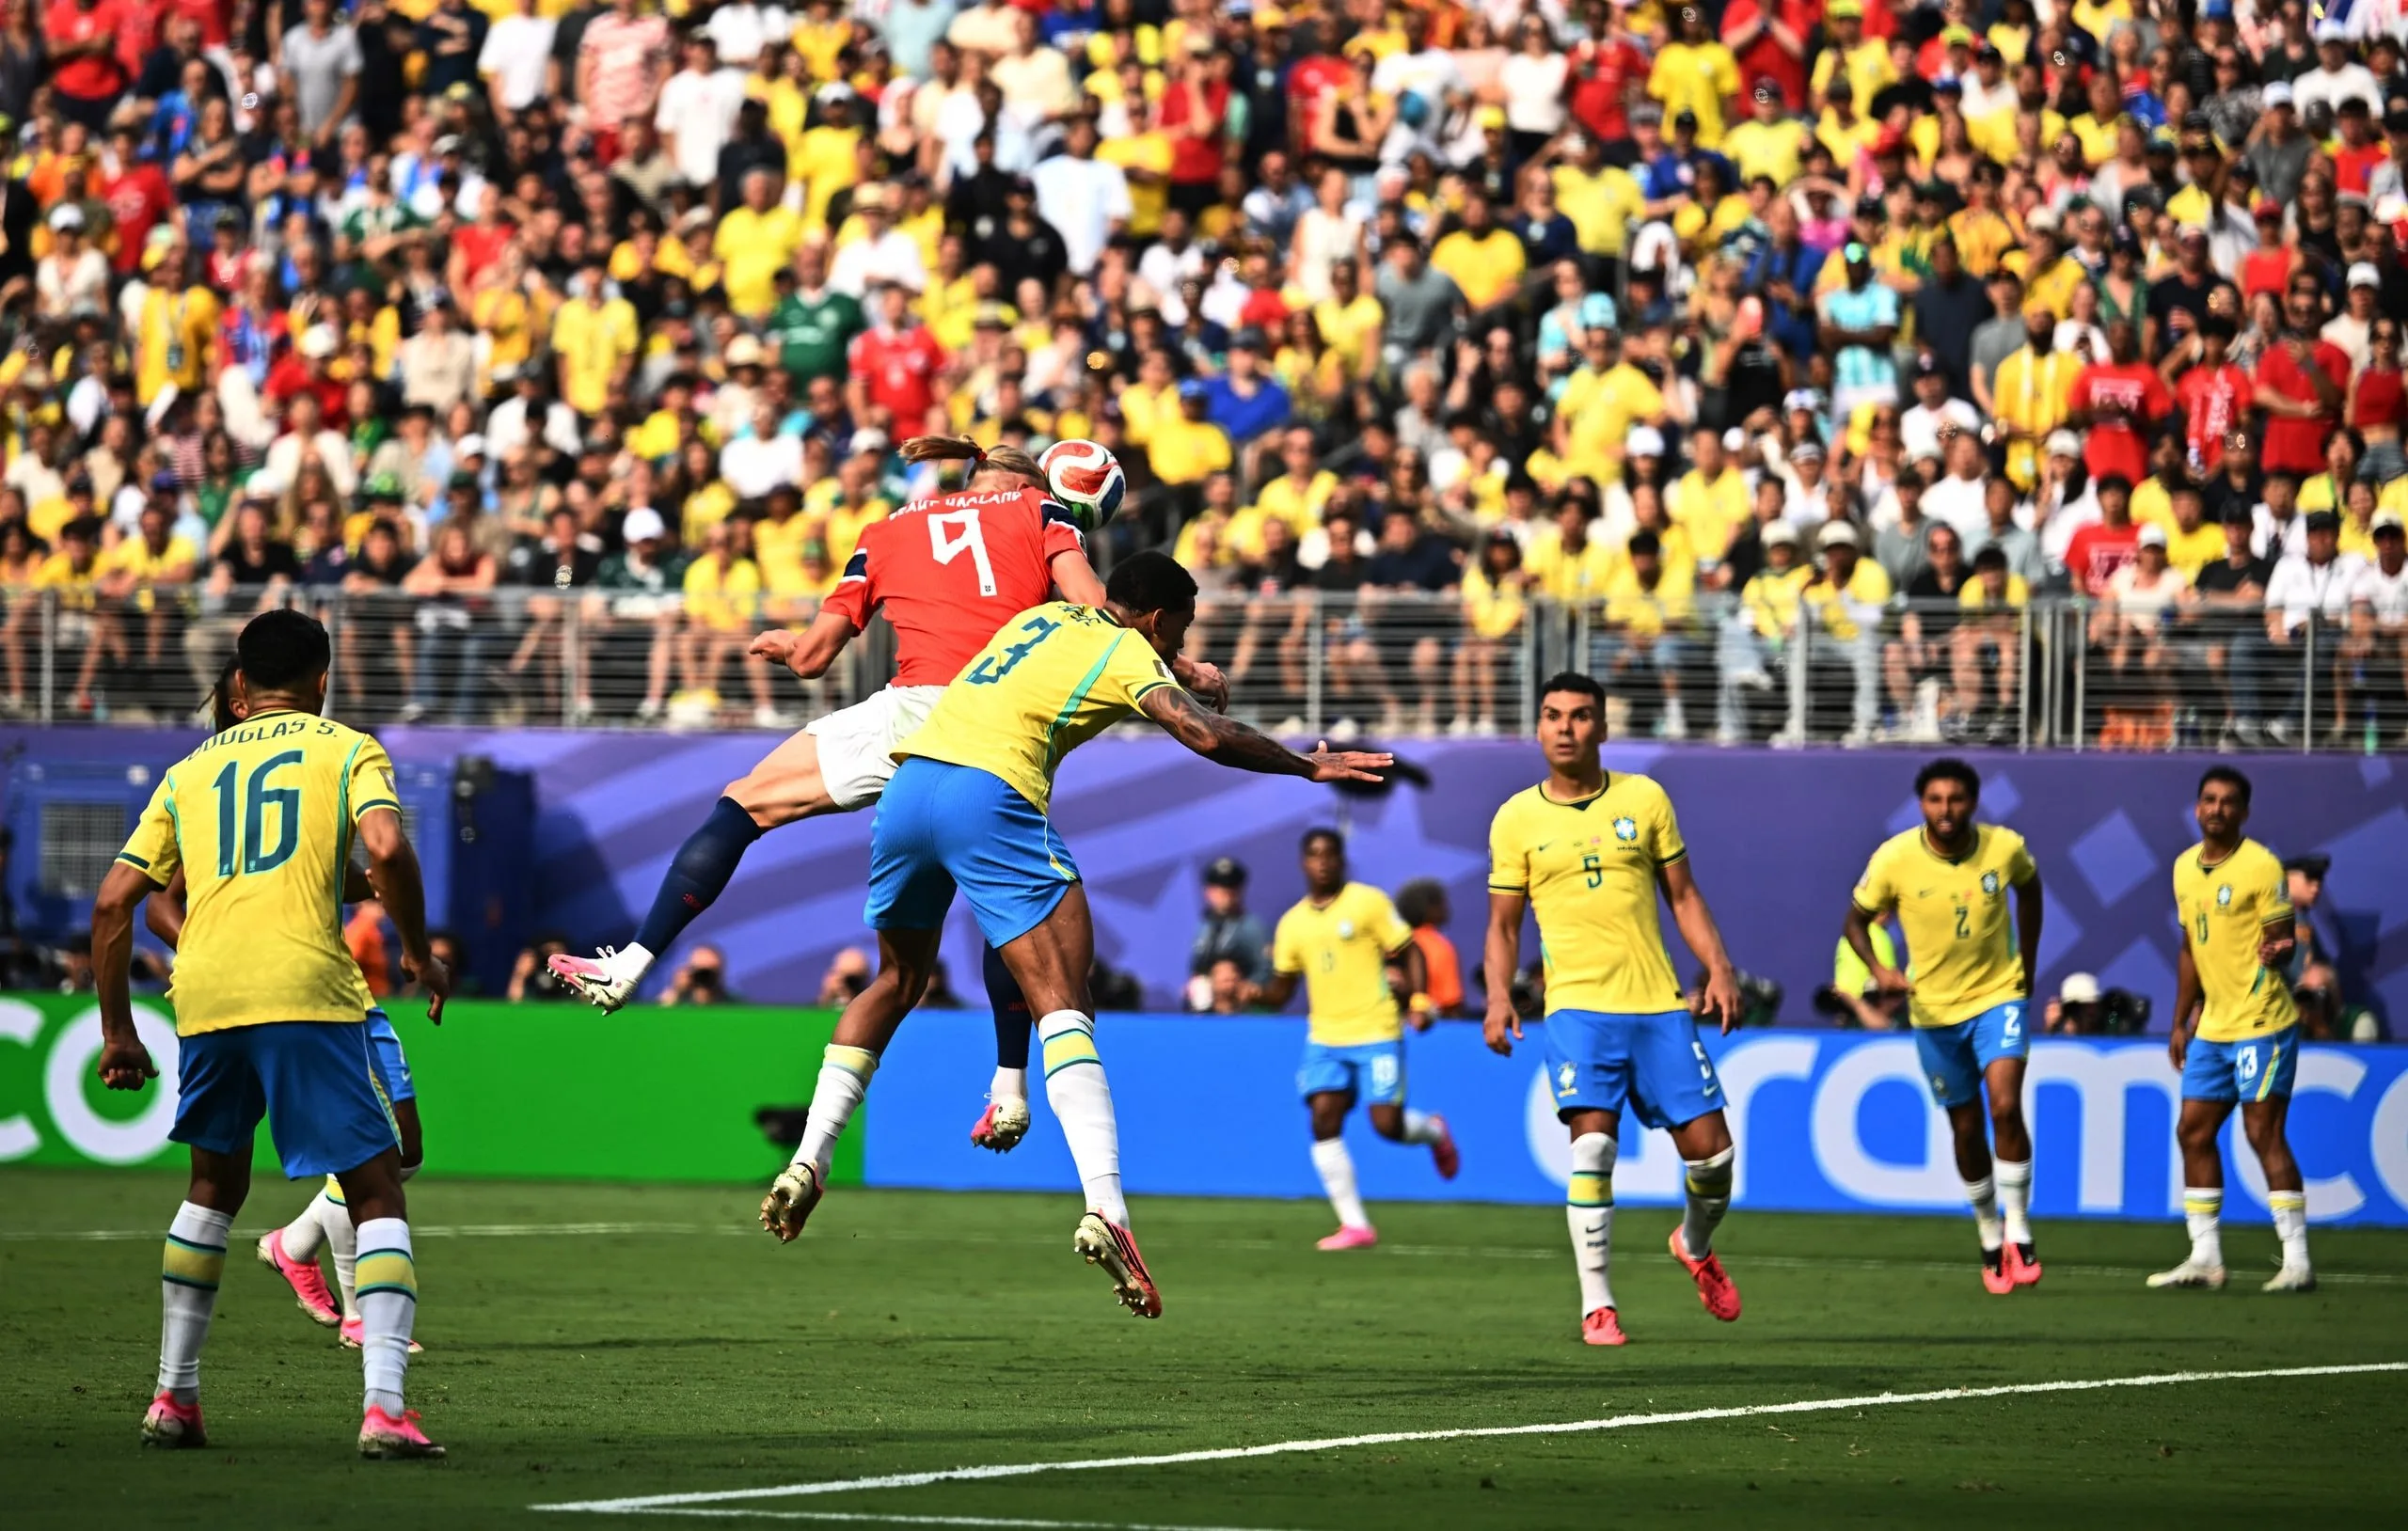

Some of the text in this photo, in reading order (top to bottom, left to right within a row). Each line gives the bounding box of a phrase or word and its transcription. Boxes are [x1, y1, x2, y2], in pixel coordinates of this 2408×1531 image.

[927, 508, 998, 597] 9
[963, 616, 1063, 686] 3
[315, 721, 338, 738] S.
[213, 750, 303, 876] 16
[1583, 856, 1603, 889] 5
[1955, 906, 1971, 939] 2
[2004, 1004, 2021, 1037] 2
[1691, 1041, 1712, 1080] 5
[2236, 1045, 2258, 1080] 13
[1526, 1034, 2408, 1222] aramc
